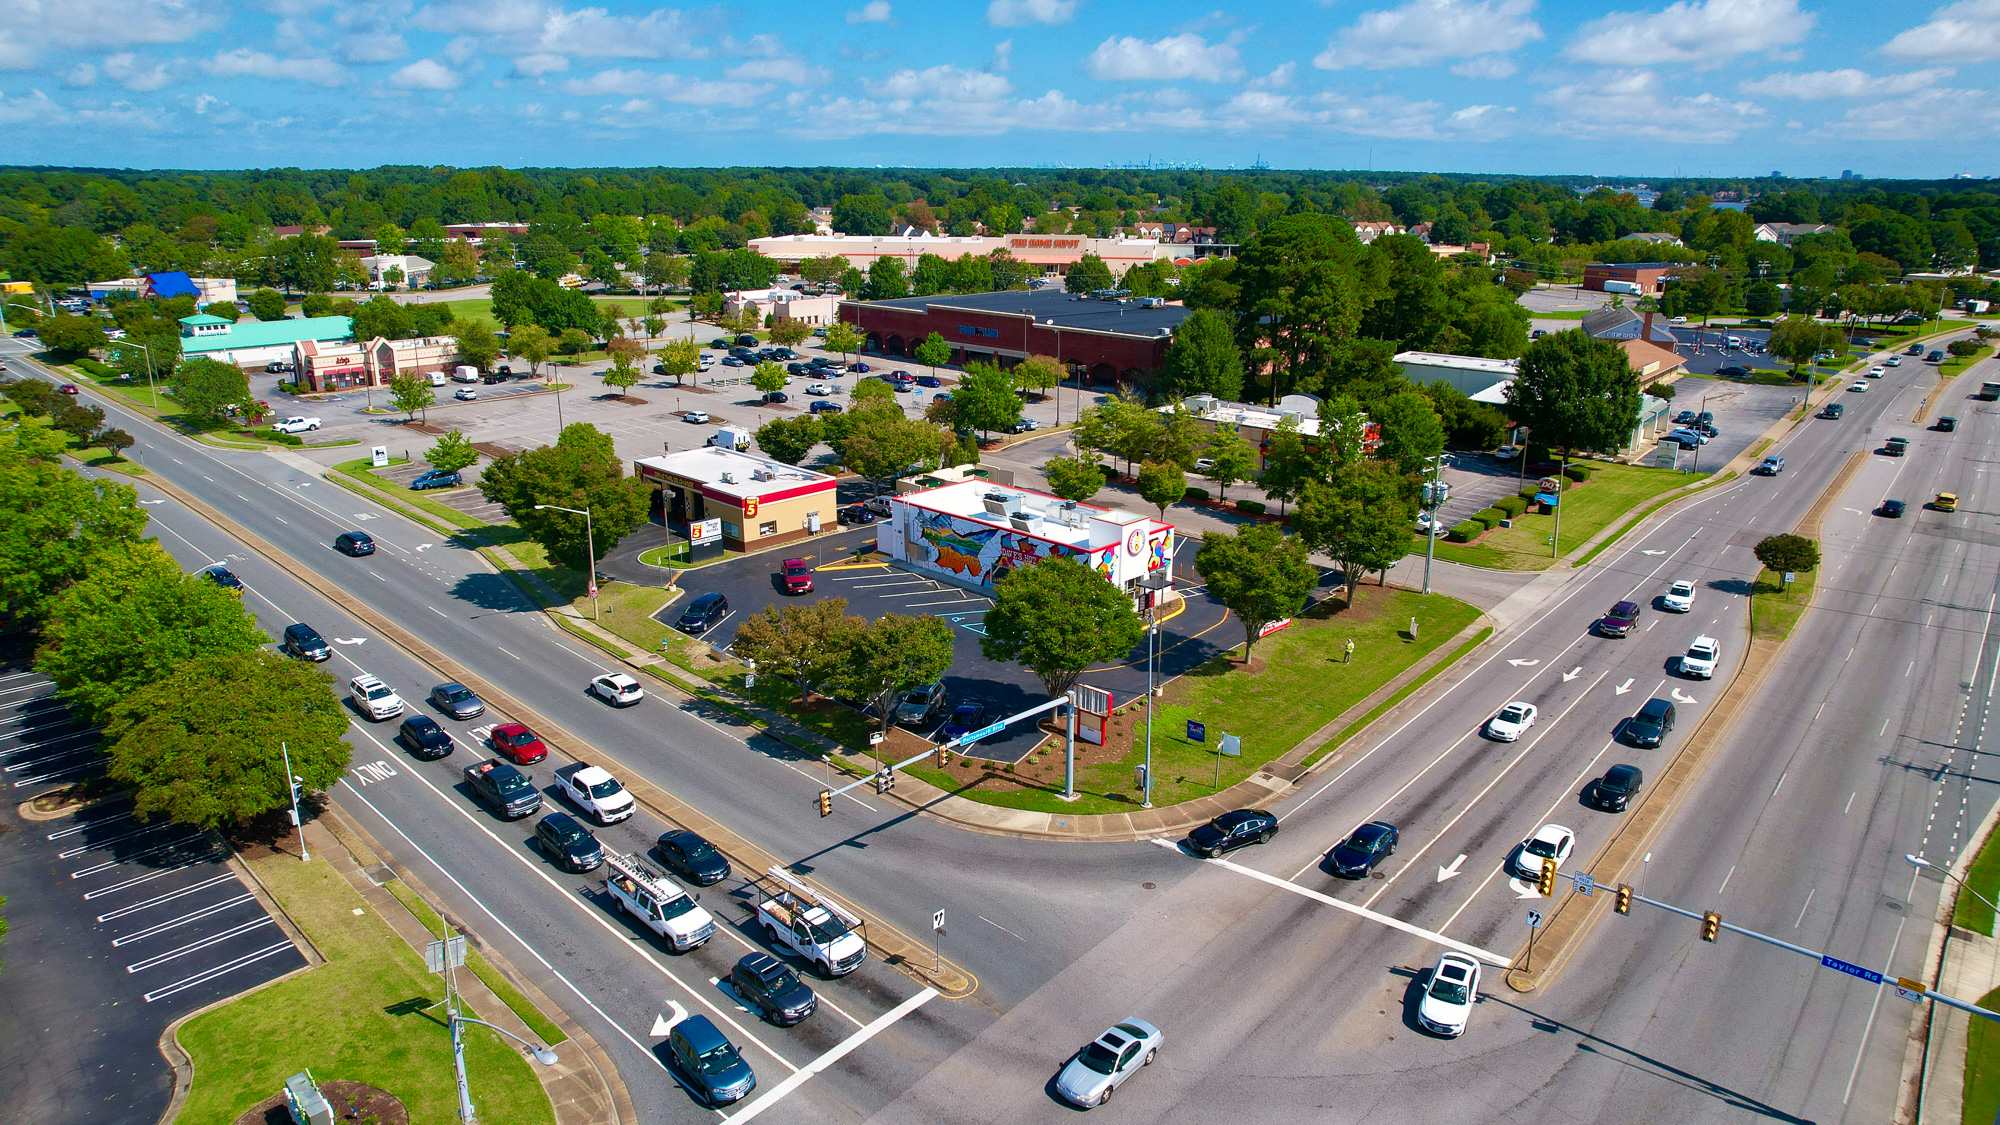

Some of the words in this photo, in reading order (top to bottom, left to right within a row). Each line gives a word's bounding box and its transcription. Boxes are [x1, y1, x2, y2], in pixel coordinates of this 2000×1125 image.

[1011, 239, 1027, 247] THE
[1029, 239, 1052, 247] HOME
[1054, 239, 1080, 247] DEPOT
[1541, 481, 1554, 489] DQ
[747, 504, 755, 515] 5
[693, 529, 700, 538] 5
[1024, 554, 1037, 565] HOT
[963, 729, 991, 742] Portsmouth
[992, 724, 1003, 732] Blvd
[351, 761, 397, 786] ONLY
[1827, 958, 1860, 974] Taylor
[1864, 971, 1878, 981] Rd
